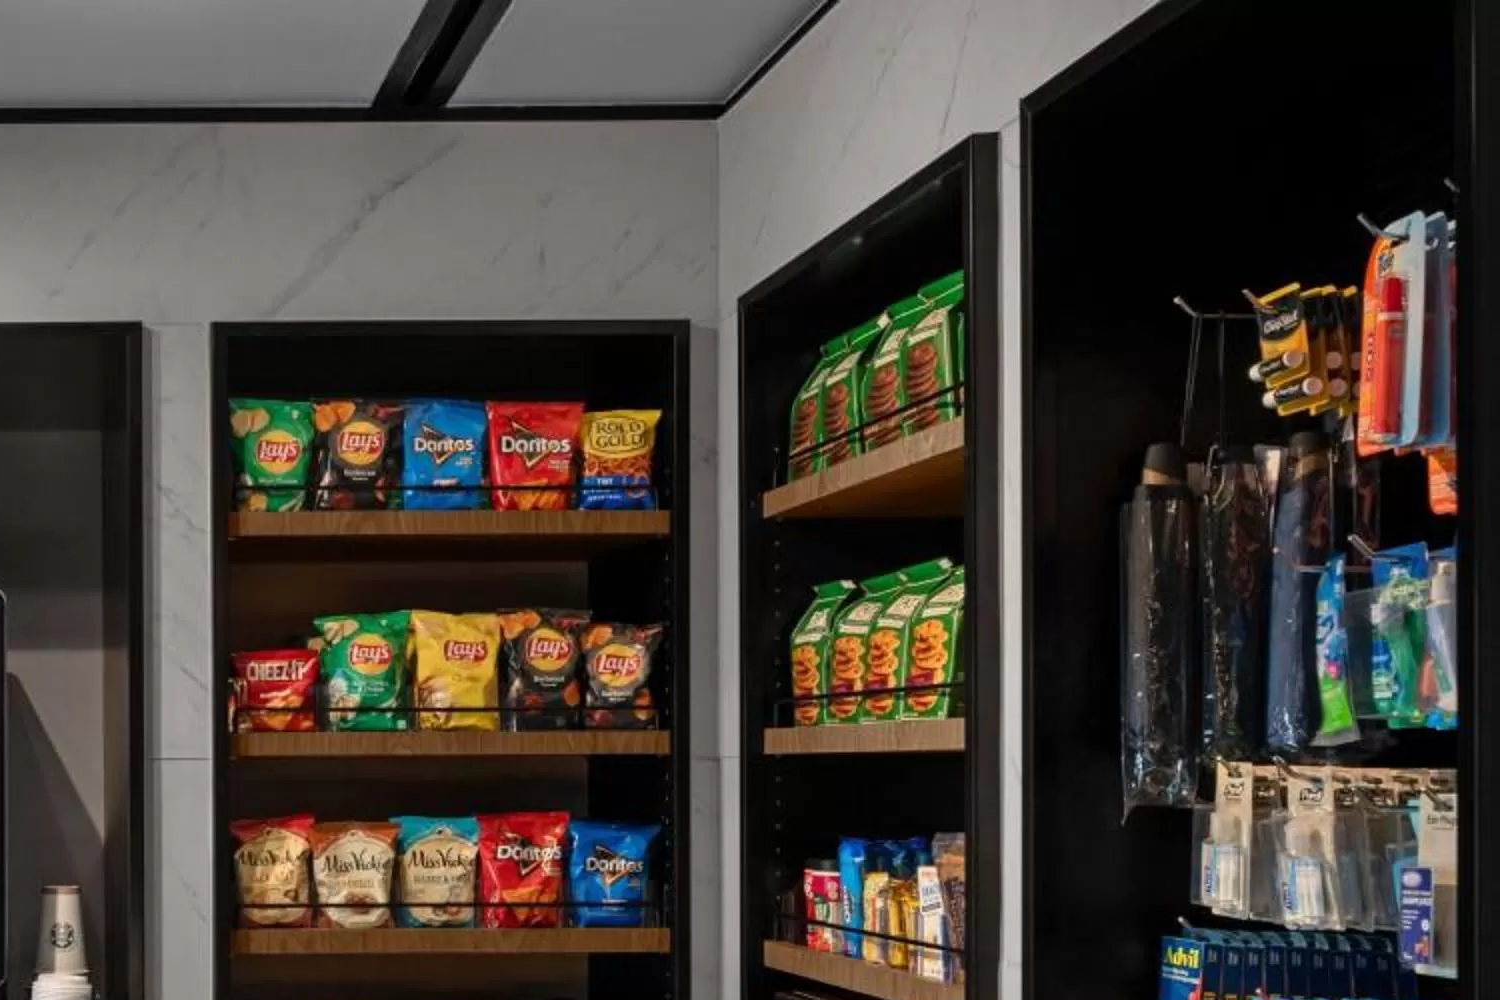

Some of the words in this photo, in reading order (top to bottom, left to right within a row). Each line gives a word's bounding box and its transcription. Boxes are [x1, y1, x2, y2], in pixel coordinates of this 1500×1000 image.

[259, 439, 298, 461] Lay's
[342, 431, 381, 454] Lay's
[414, 437, 474, 454] Doritos
[501, 436, 571, 454] Doritos
[352, 642, 390, 663] Lay's
[446, 640, 486, 661] Lay's
[530, 637, 571, 661] Lay's
[599, 654, 642, 677] Lay's
[496, 844, 563, 861] Doritos
[585, 857, 644, 873] Doritos
[1163, 945, 1200, 969] Advil
